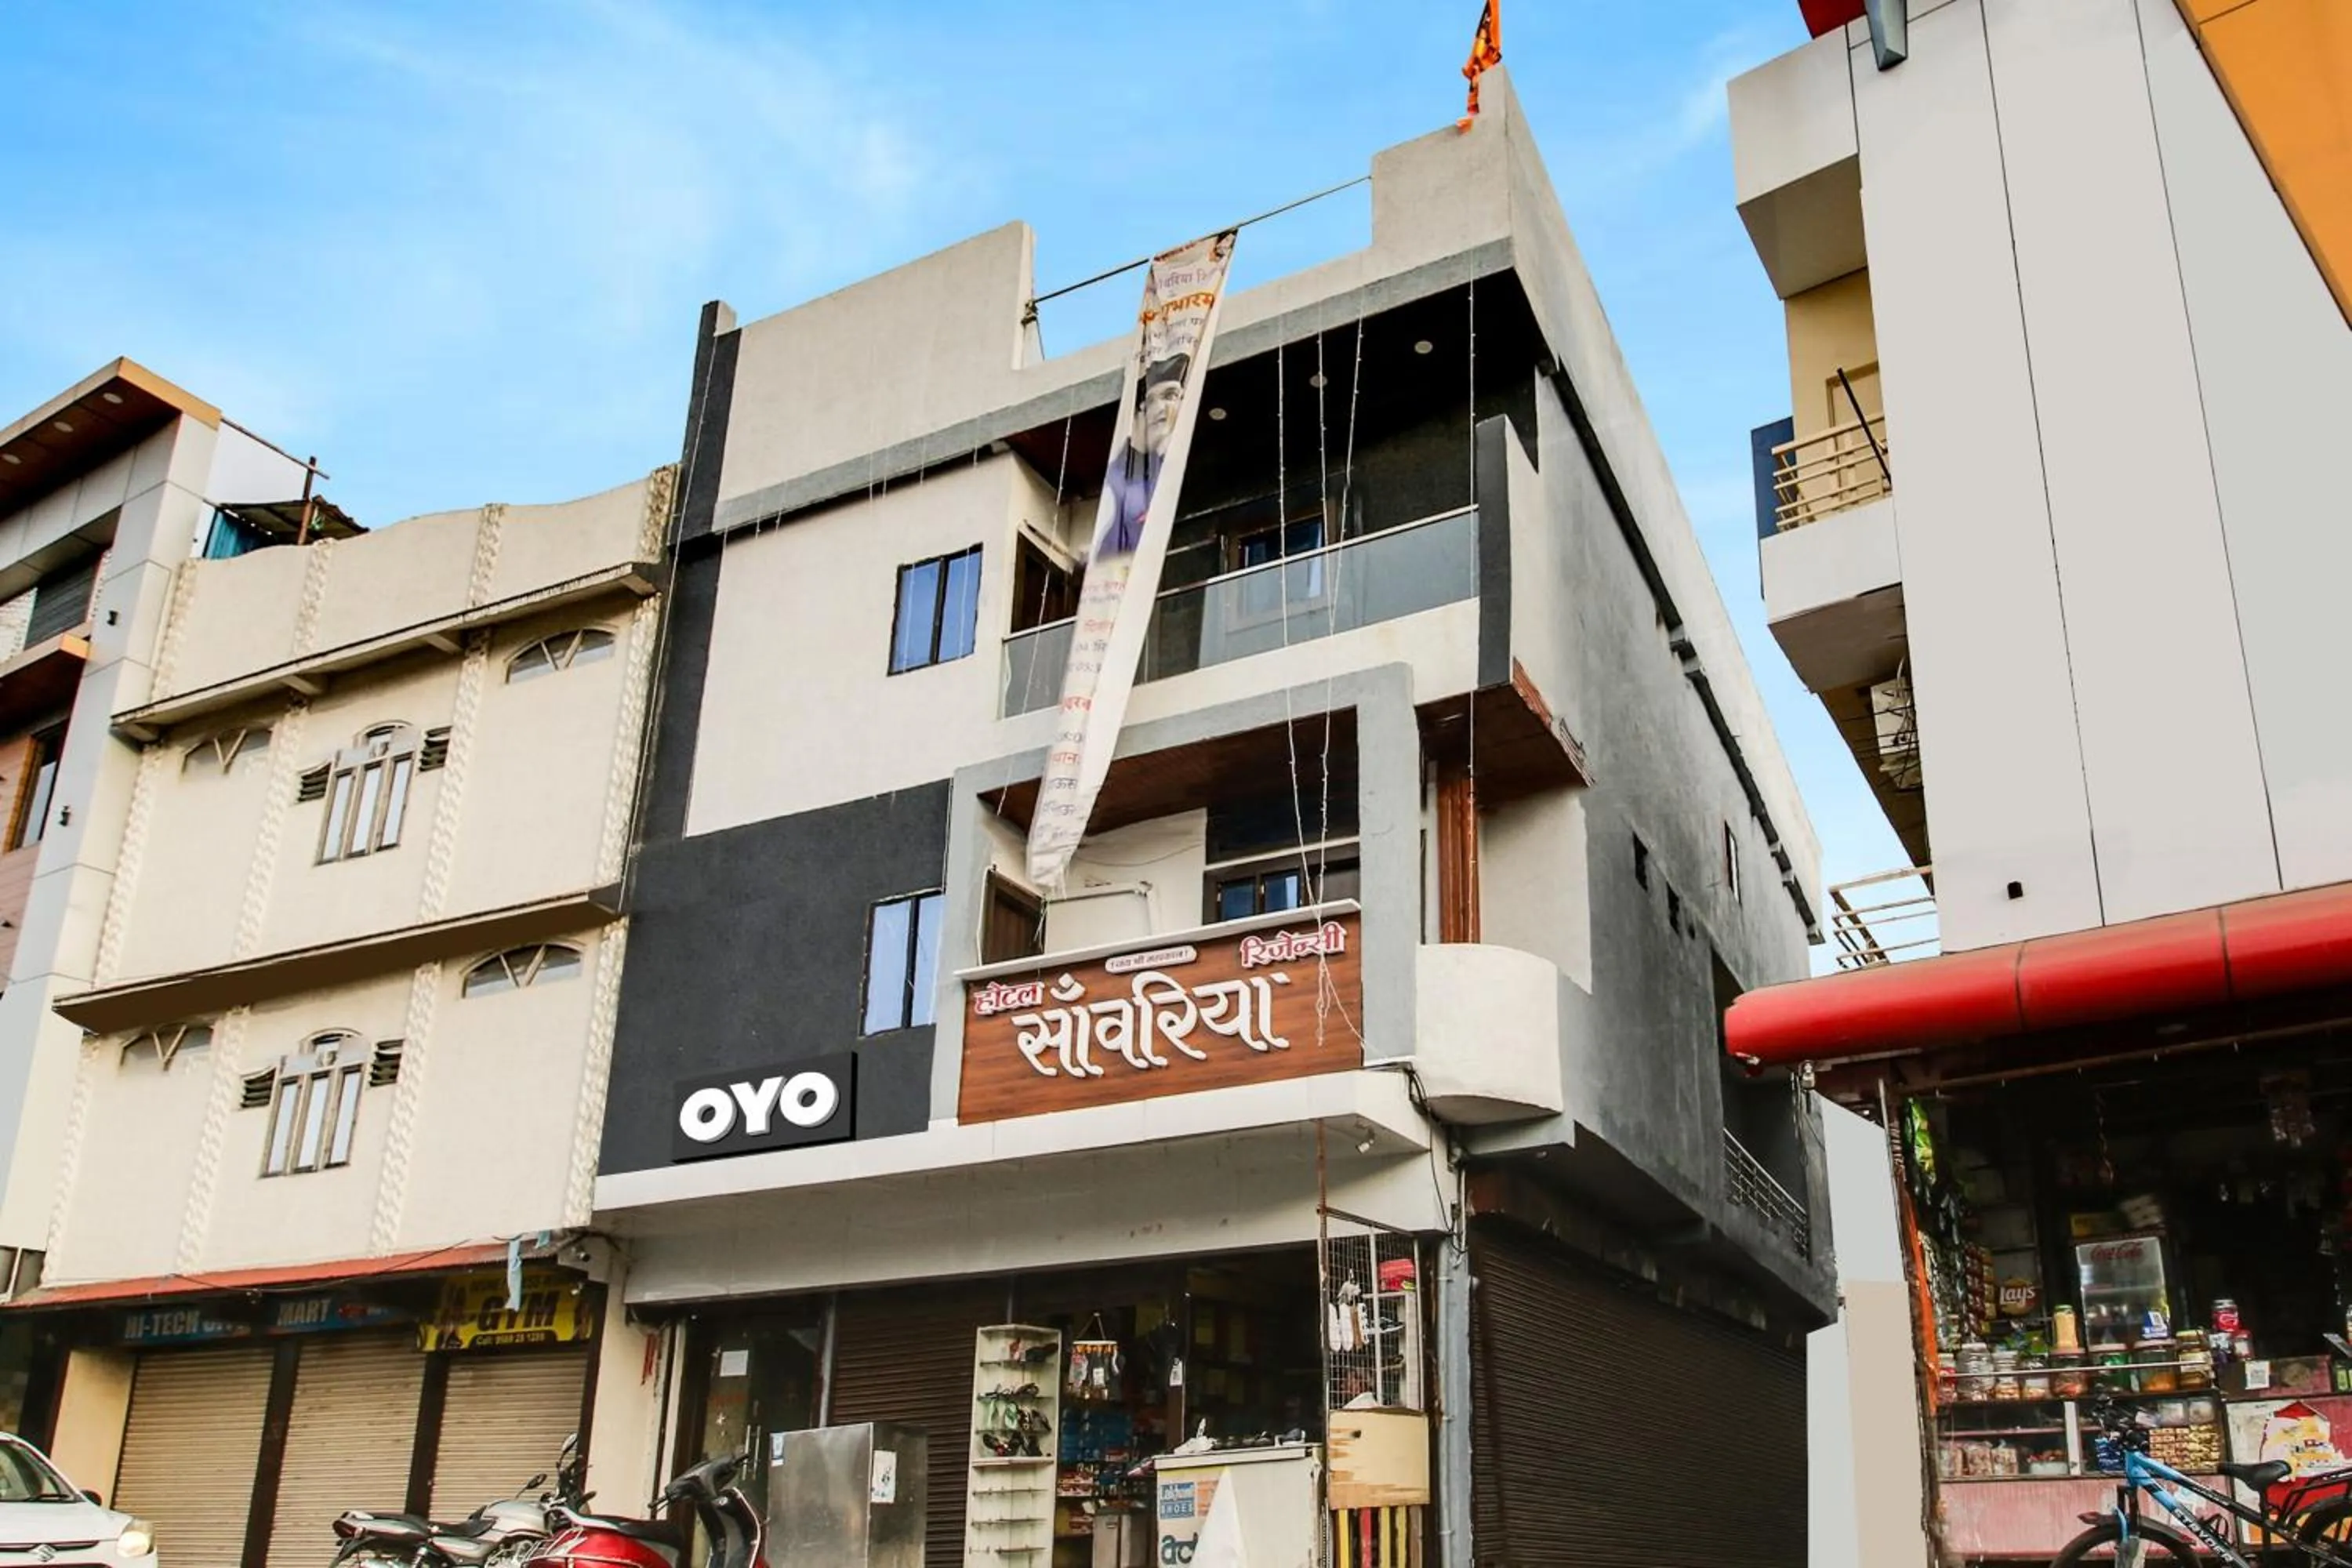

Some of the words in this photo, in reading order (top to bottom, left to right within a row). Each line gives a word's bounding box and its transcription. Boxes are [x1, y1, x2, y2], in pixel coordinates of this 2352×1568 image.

[974, 981, 1044, 1014] होटल
[679, 1072, 839, 1143] OYO
[125, 1310, 200, 1338] HI-TECH
[277, 1298, 331, 1326] MART
